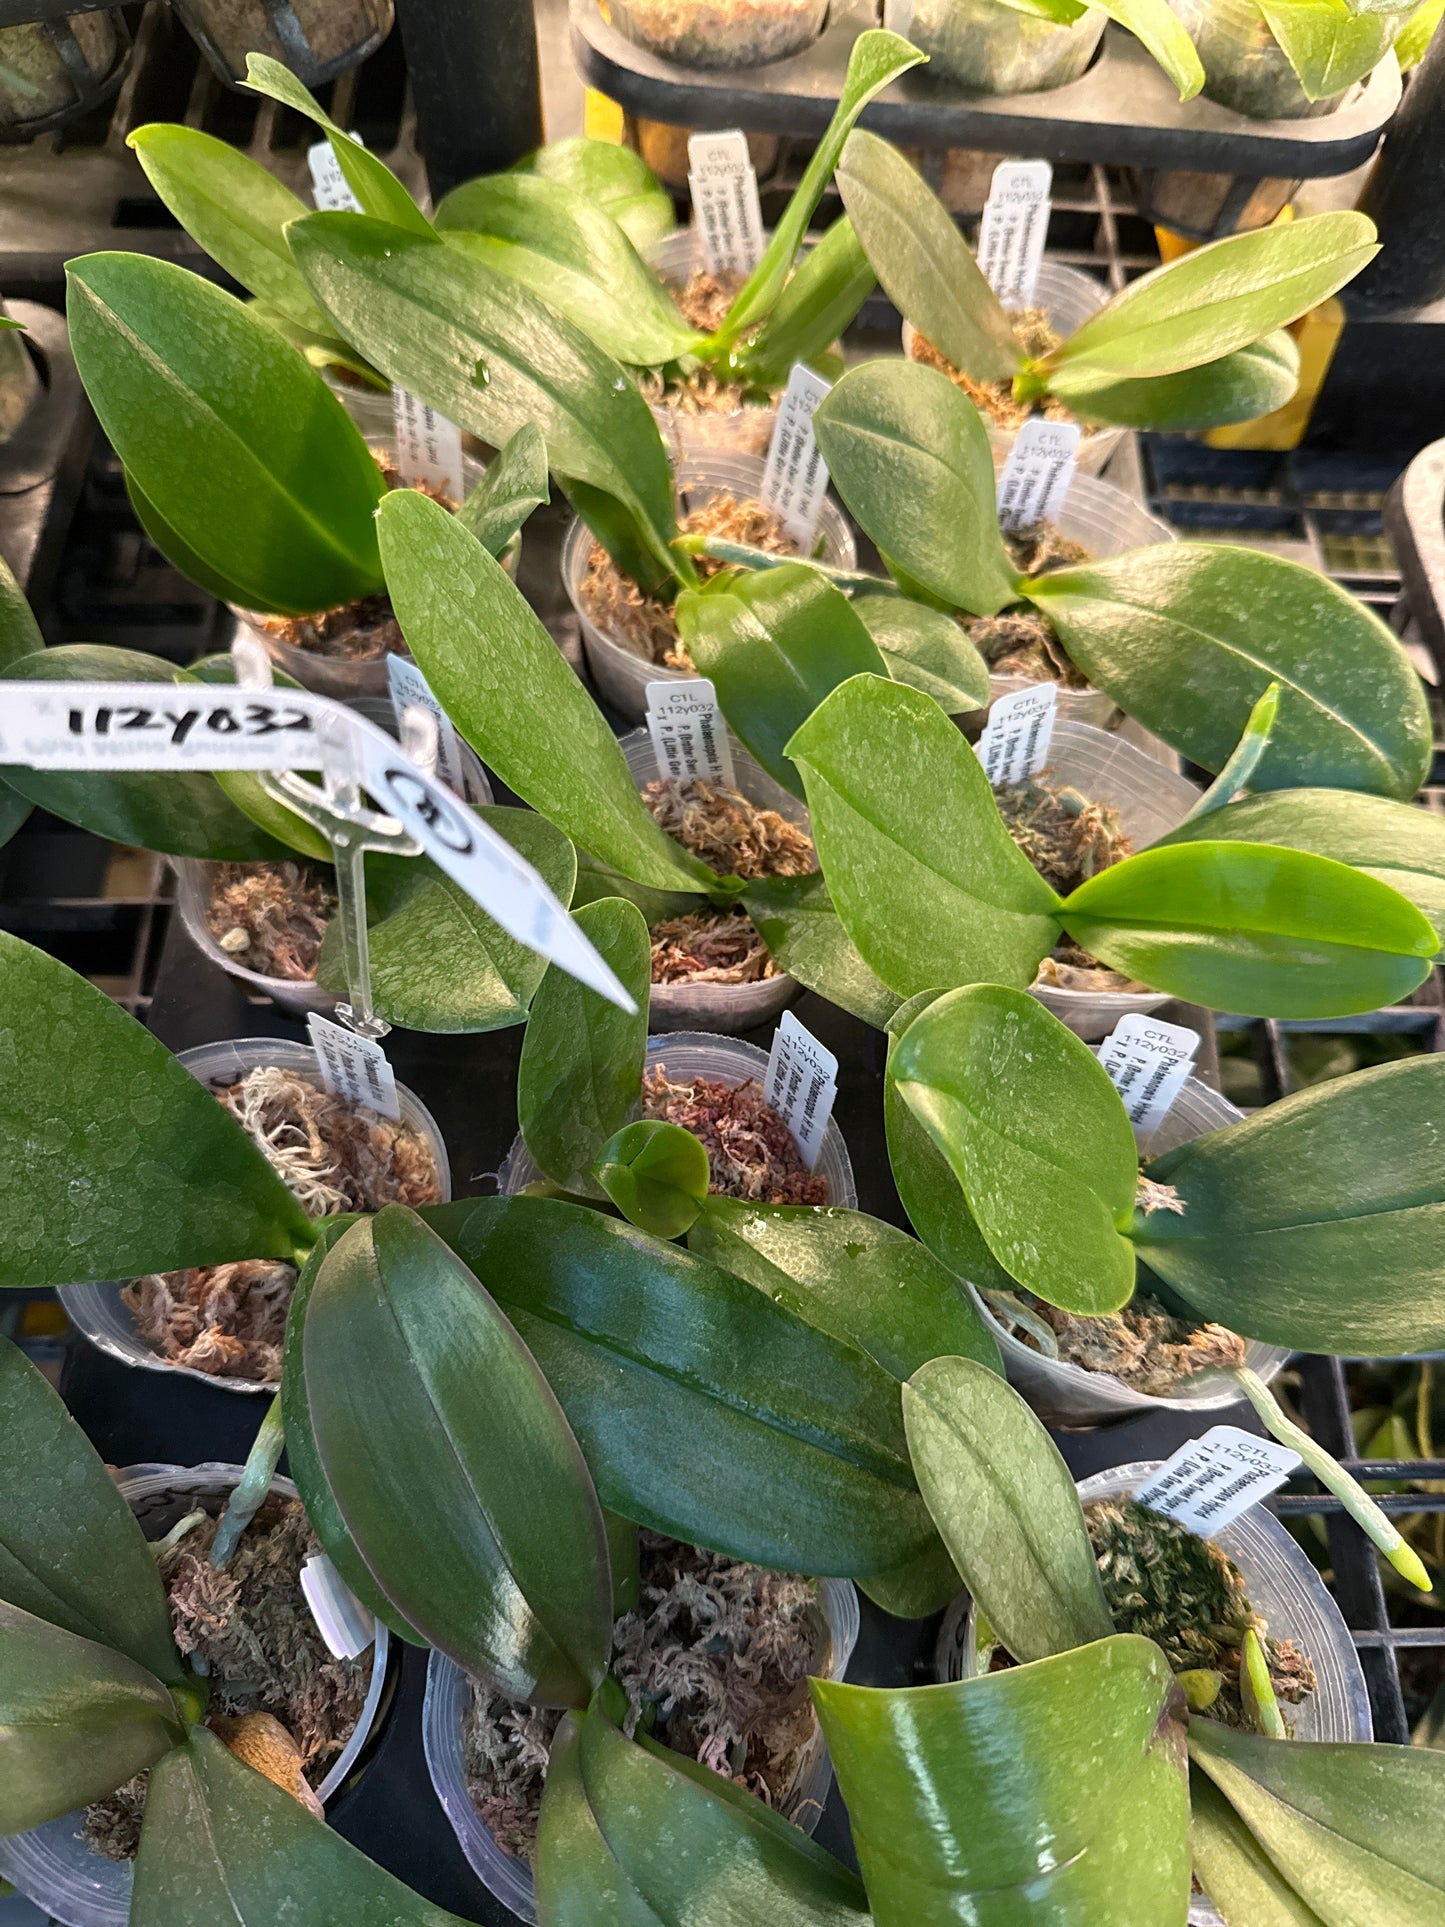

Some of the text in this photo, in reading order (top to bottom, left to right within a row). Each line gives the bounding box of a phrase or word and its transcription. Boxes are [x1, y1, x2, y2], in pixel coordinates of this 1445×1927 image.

[698, 713, 719, 764] Phalaenopsis
[1144, 1030, 1174, 1045] CTL
[1237, 1443, 1272, 1461] CTL
